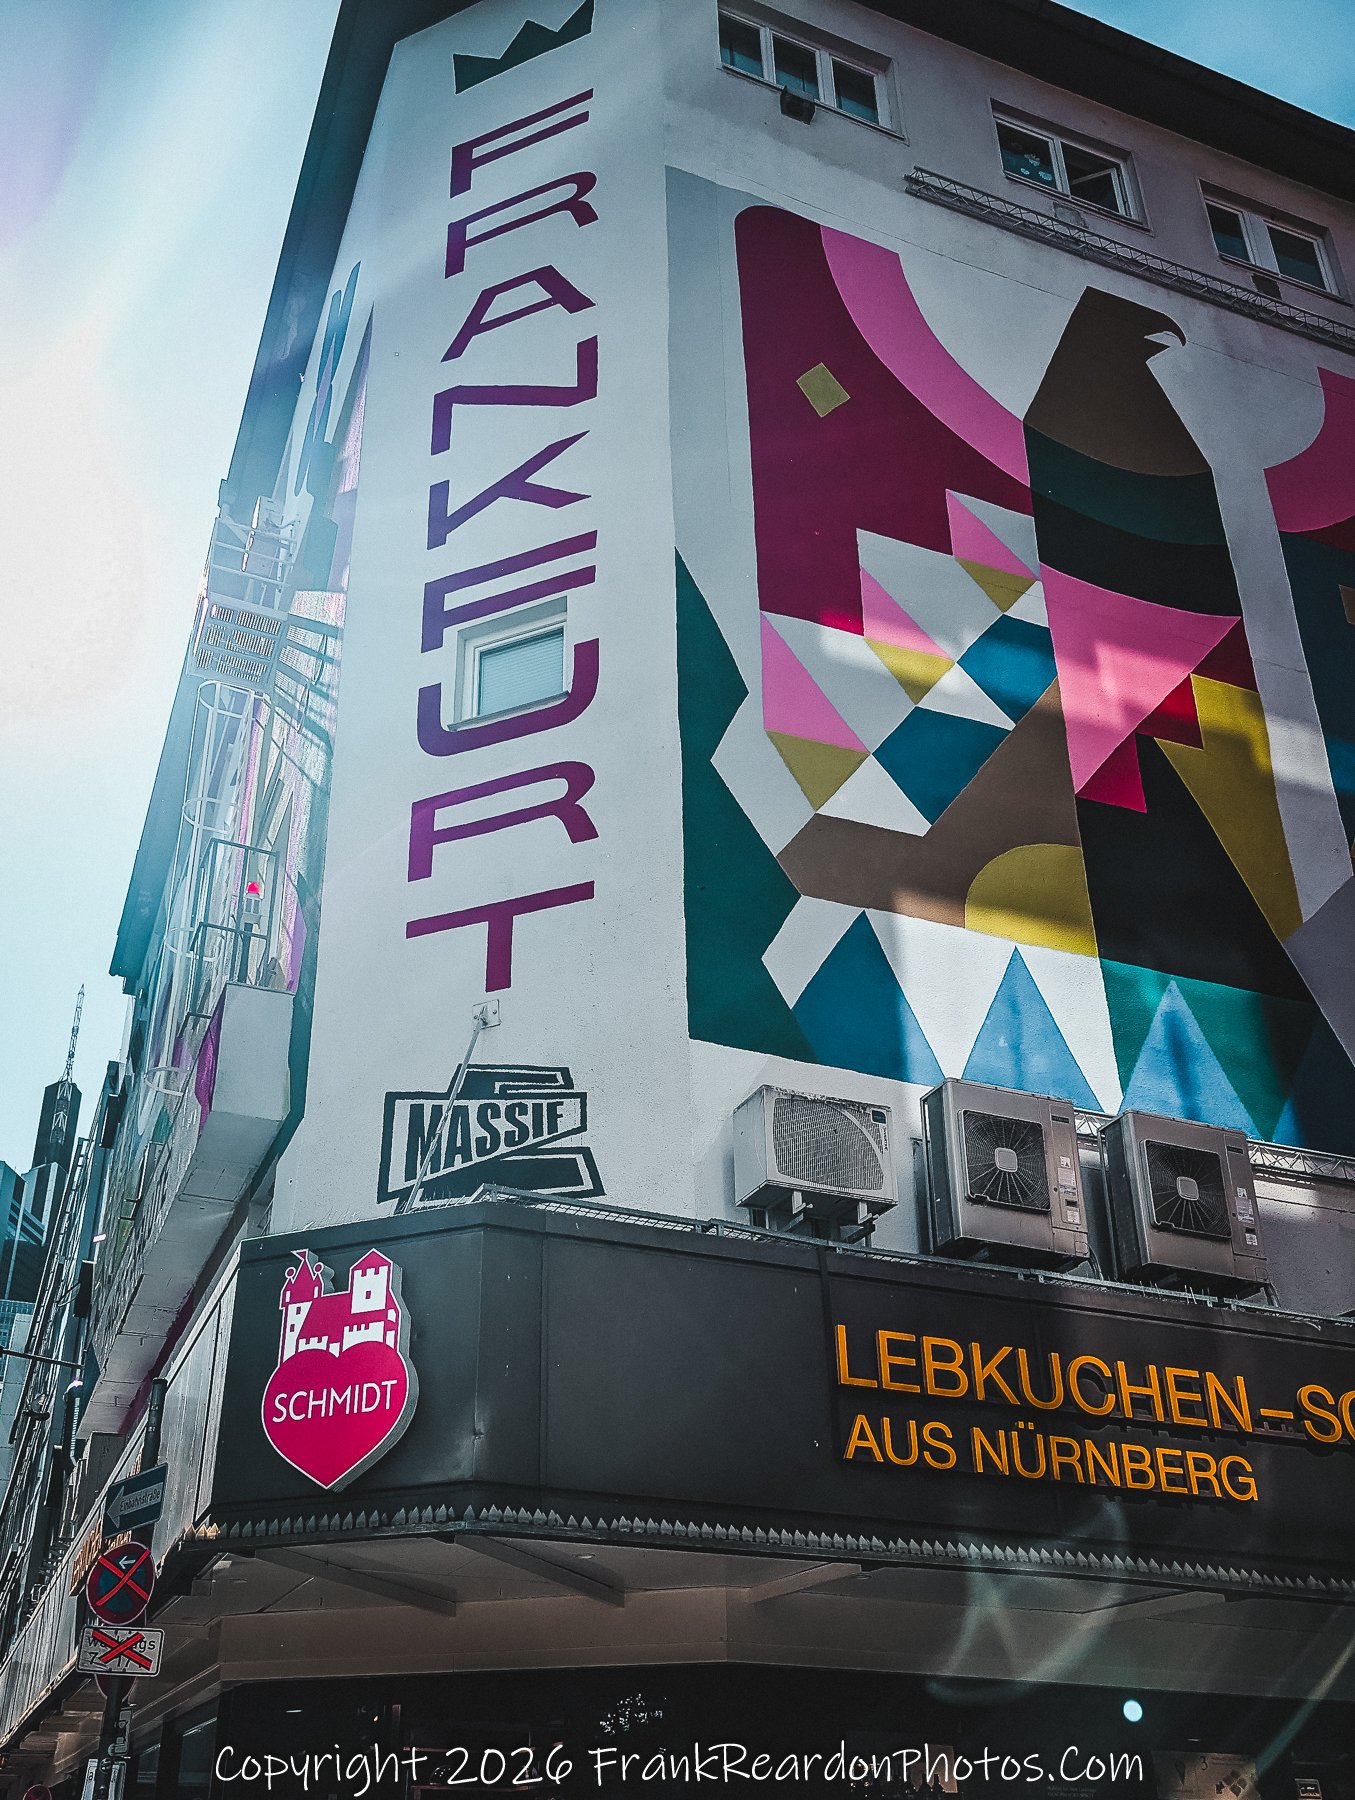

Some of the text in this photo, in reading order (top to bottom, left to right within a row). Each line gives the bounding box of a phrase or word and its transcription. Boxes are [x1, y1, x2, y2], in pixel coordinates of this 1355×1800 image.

[405, 88, 600, 993] FRANKFURT
[404, 1101, 564, 1182] MASSIF
[272, 1379, 398, 1423] SCHMIDT
[843, 1414, 1259, 1501] AUS NÜRNBERG
